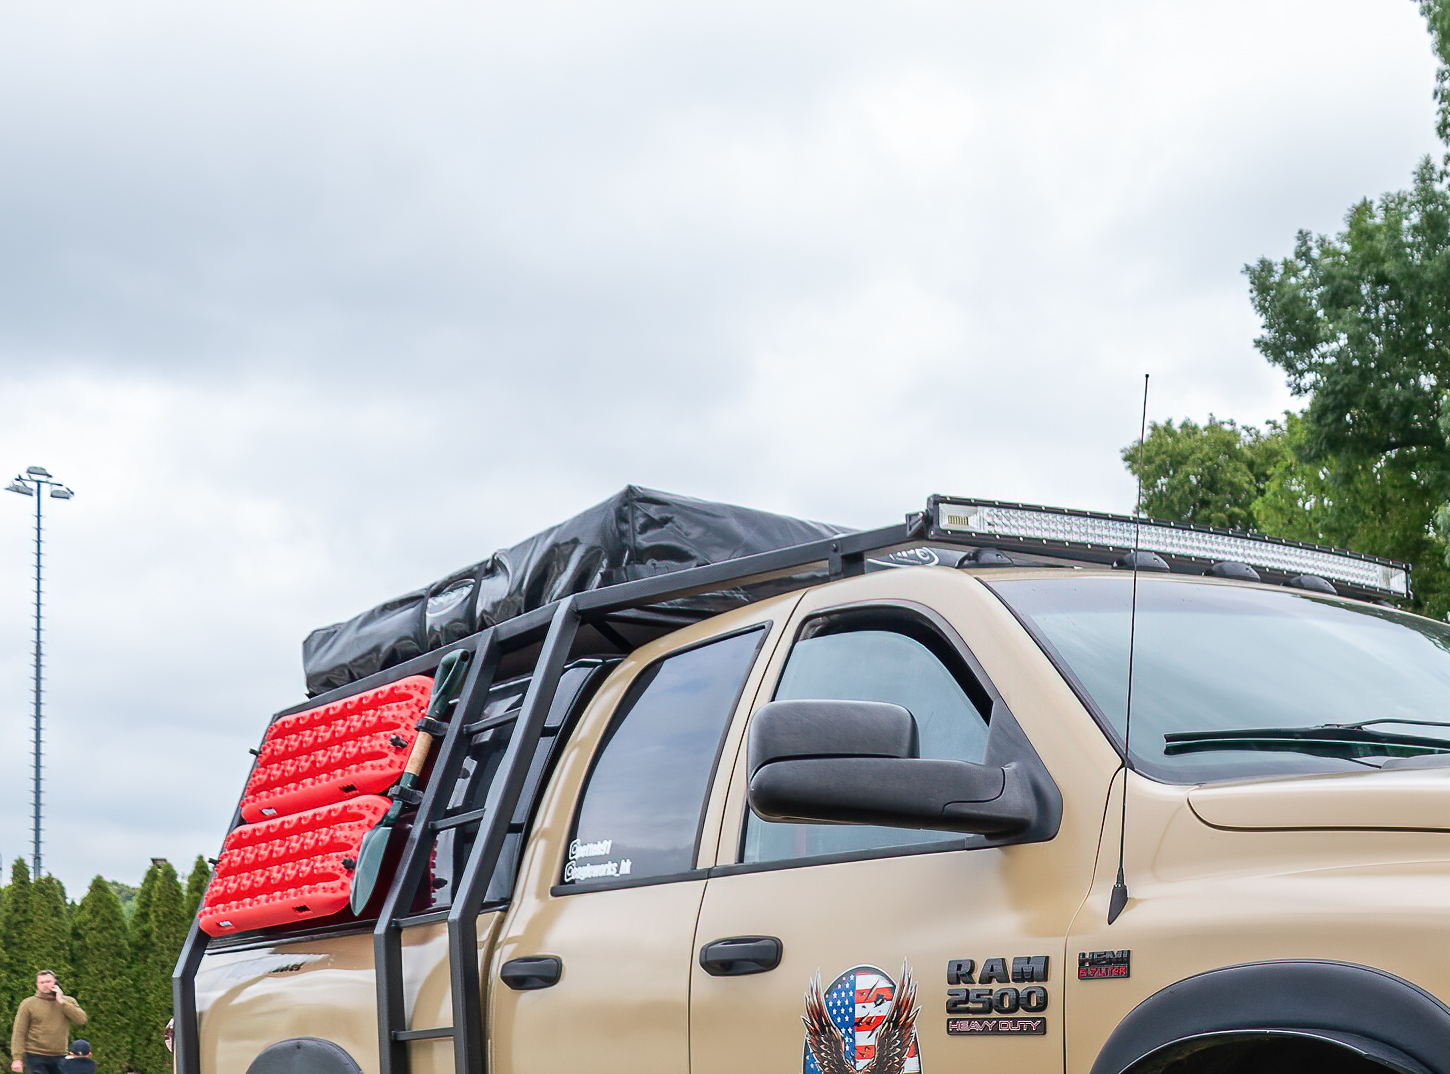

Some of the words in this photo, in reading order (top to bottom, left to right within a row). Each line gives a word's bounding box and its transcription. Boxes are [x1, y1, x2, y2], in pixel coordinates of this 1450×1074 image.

[946, 955, 1050, 985] RAM
[1078, 950, 1131, 967] HEMI
[946, 986, 1049, 1015] 2500
[948, 1020, 997, 1032] HEAVY
[998, 1020, 1042, 1031] DUTY
